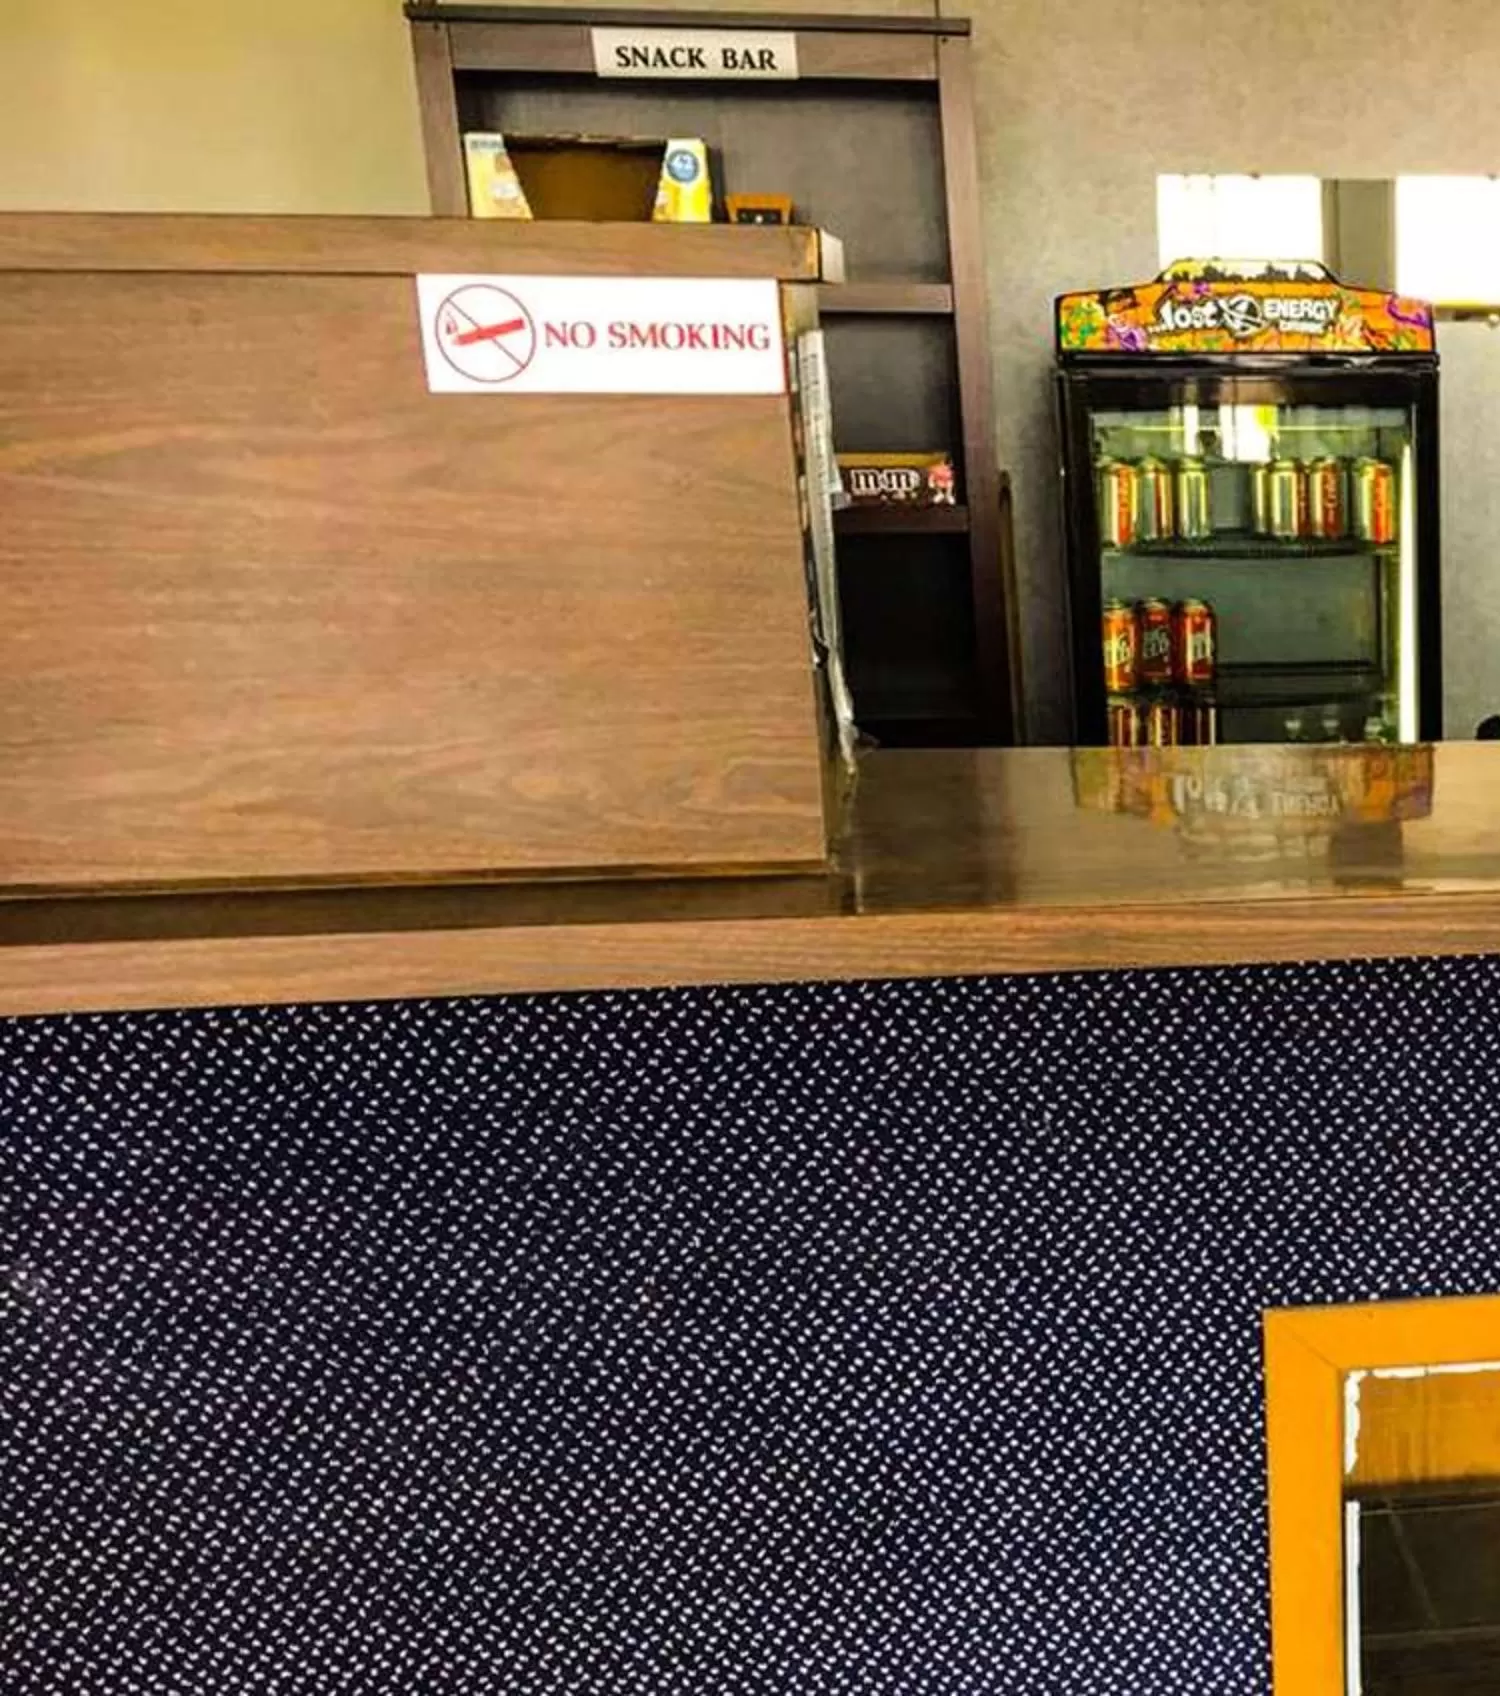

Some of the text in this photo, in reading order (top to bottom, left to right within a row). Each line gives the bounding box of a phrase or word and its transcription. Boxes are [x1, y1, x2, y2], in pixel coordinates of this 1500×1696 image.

[615, 45, 778, 71] SNACK BAR
[1263, 300, 1338, 320] ENERGY
[543, 321, 770, 351] NO SMOKING
